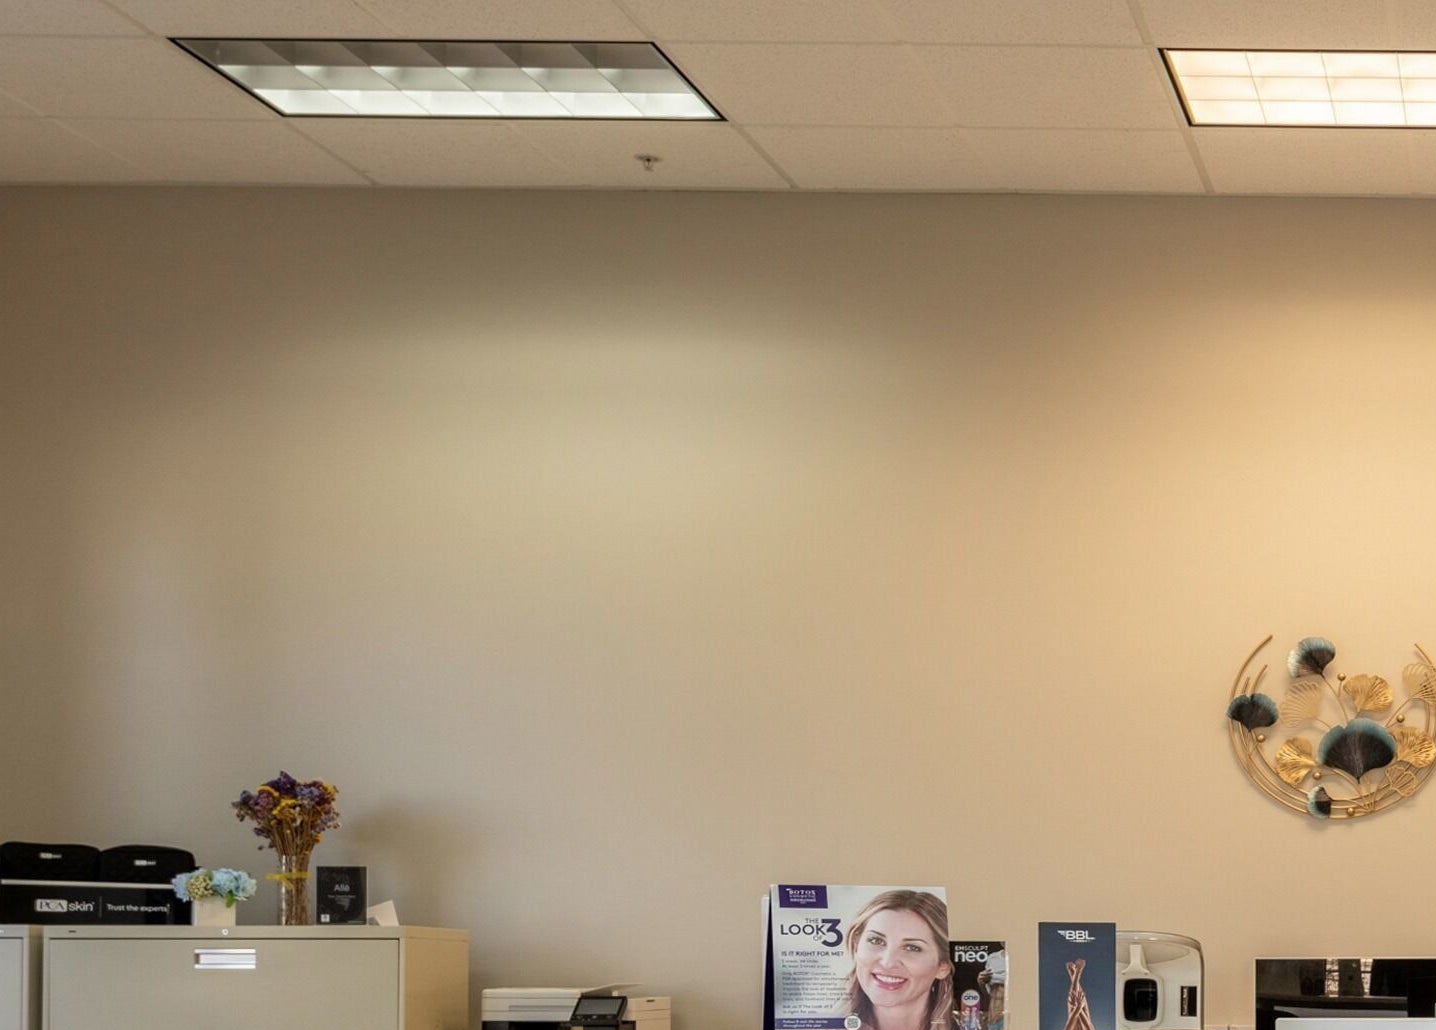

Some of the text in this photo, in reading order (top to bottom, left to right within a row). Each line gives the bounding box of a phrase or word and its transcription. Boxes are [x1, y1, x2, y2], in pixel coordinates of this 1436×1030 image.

[69, 901, 93, 912] skin
[126, 904, 139, 912] the
[780, 924, 826, 935] LOOK
[821, 919, 843, 947] 3
[1064, 930, 1096, 940] BBL
[954, 951, 988, 963] neo
